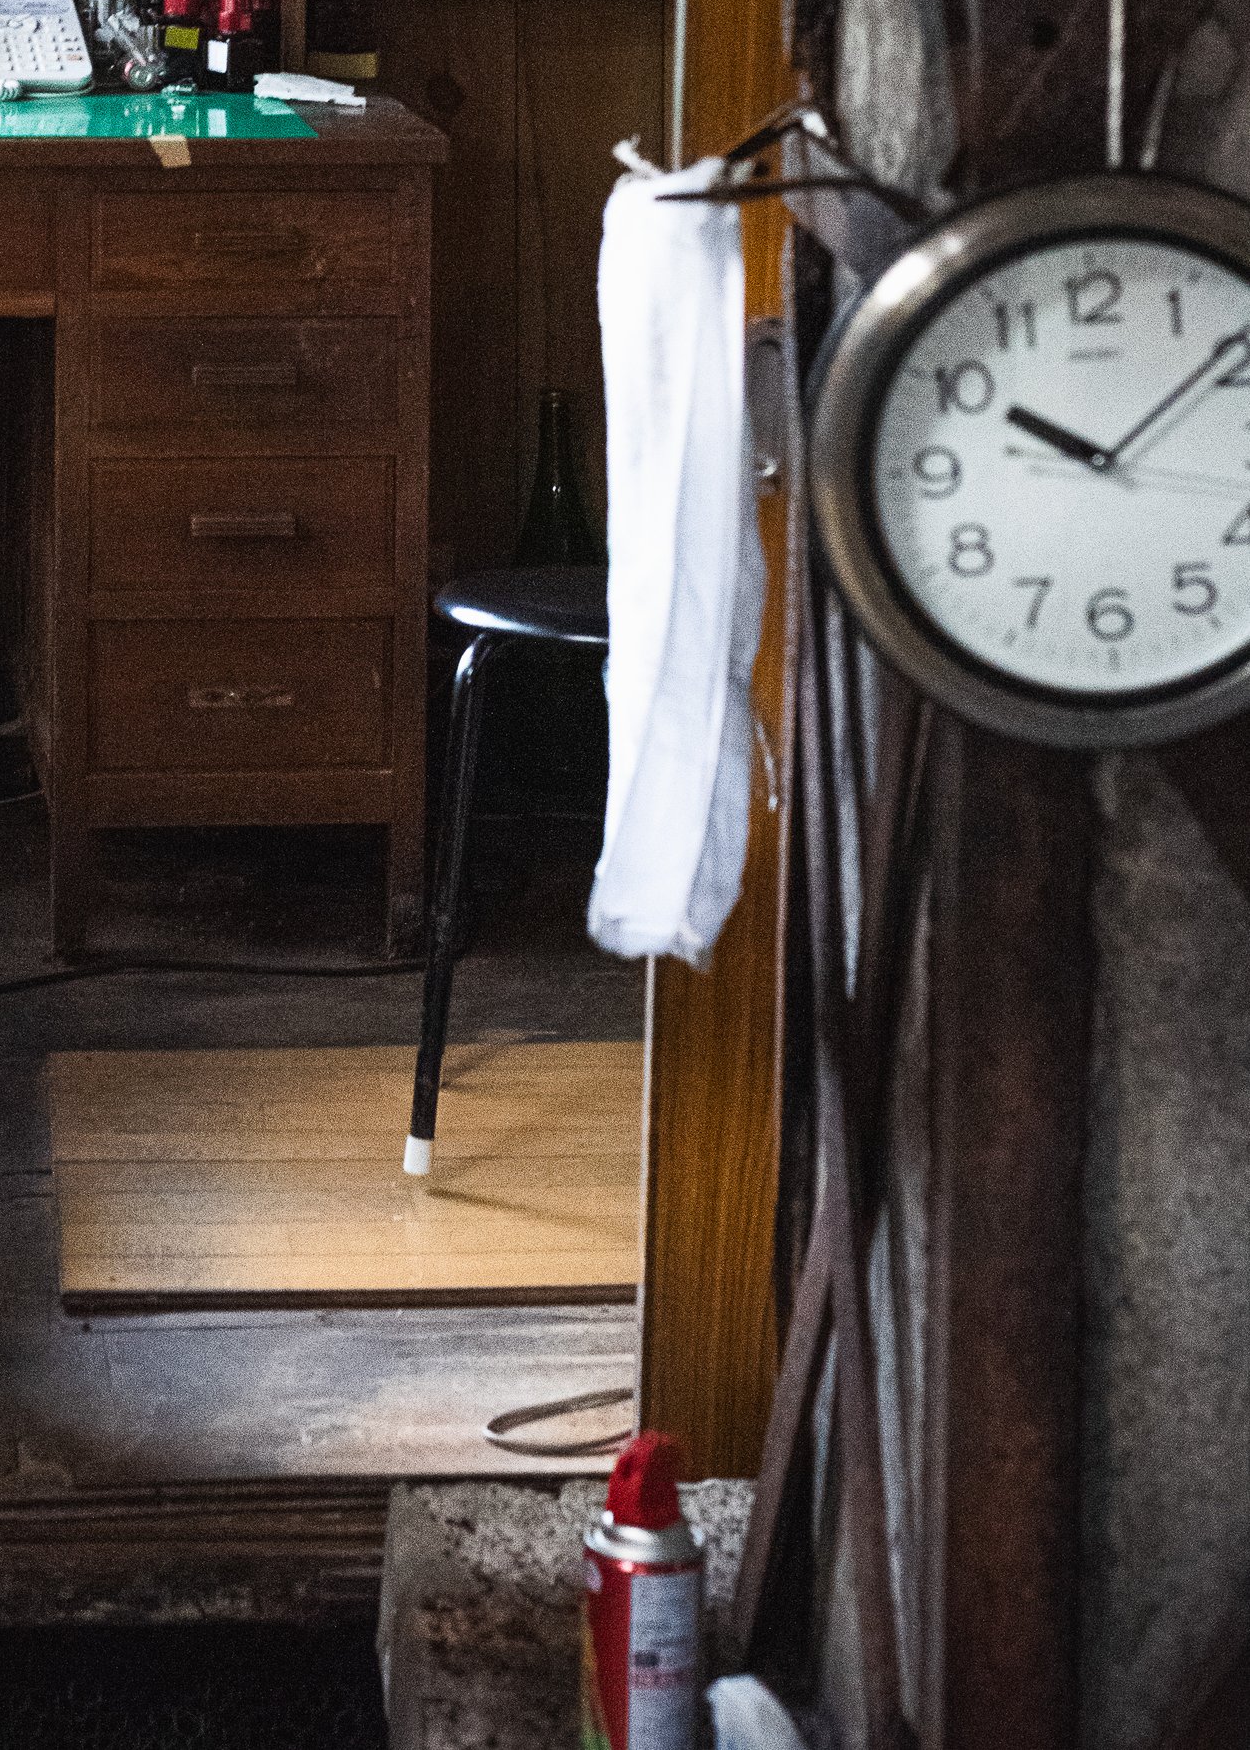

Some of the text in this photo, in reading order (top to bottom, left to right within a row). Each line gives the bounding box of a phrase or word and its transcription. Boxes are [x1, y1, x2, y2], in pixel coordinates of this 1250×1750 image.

[994, 300, 1038, 349] 11
[1064, 268, 1124, 326] 12
[1166, 287, 1184, 338] 1
[934, 358, 996, 415] 10
[912, 443, 963, 499] 9
[948, 521, 995, 578] 8
[1013, 574, 1053, 630] 7
[1085, 586, 1136, 643] 6
[1170, 561, 1219, 617] 5
